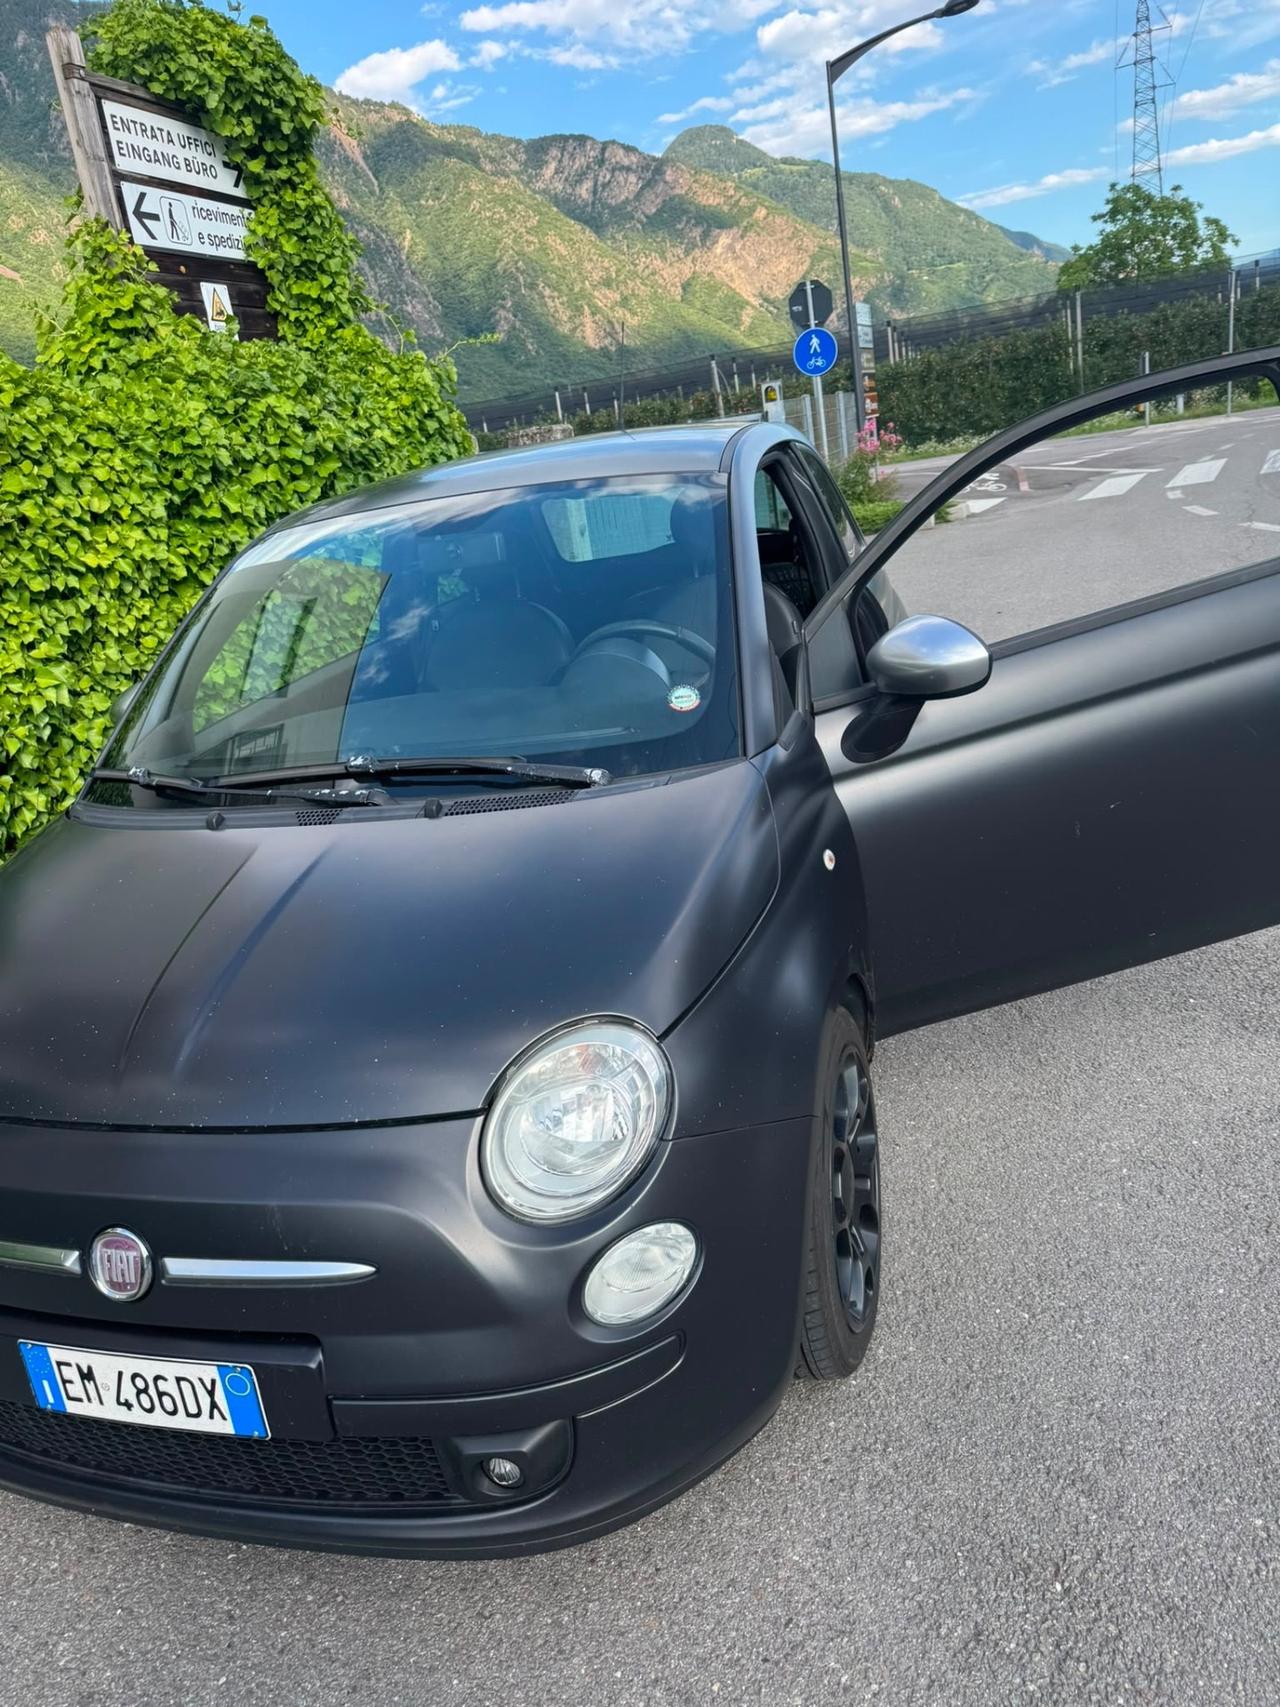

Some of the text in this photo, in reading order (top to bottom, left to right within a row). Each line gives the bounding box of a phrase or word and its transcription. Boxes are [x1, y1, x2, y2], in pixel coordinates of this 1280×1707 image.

[109, 113, 217, 158] ENTRATA UFFICI
[115, 139, 219, 180] EINGANG BÜRO
[191, 199, 251, 229] riceviment
[197, 231, 246, 251] e spedizi
[101, 1248, 138, 1283] FIAT
[55, 1360, 228, 1421] EM 486DX
